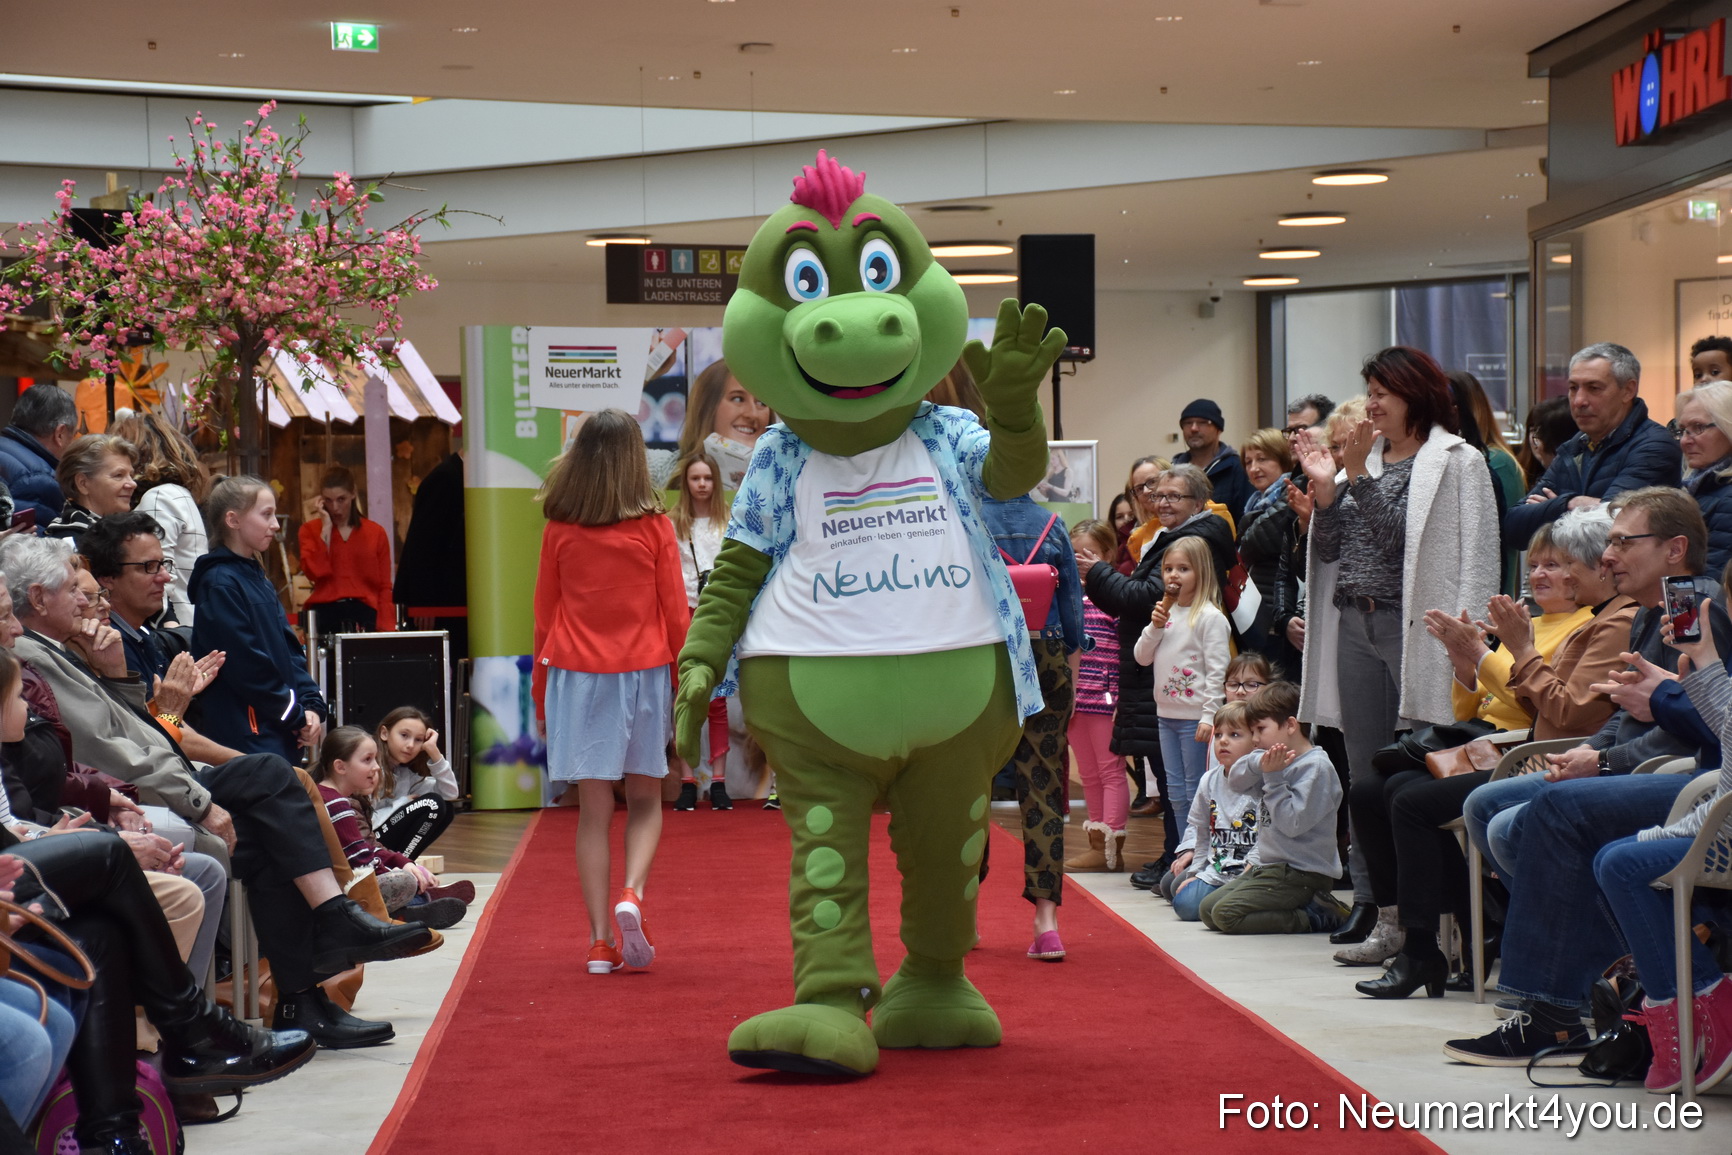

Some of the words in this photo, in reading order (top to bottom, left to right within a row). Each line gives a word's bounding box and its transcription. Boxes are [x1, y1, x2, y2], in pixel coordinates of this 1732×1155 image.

[1612, 17, 1732, 147] WÖHRL
[644, 279, 653, 287] IN
[656, 279, 673, 288] DER
[677, 279, 722, 289] UNTEREN
[644, 291, 722, 302] LADENSTRASSE
[142, 331, 151, 339] 12
[545, 366, 622, 379] NeuerMarkt
[821, 505, 948, 539] NeuerMarkt
[830, 534, 873, 550] einkaufen
[877, 531, 902, 541] leben
[906, 528, 946, 540] genießen
[405, 798, 439, 815] FRANCISCO
[403, 835, 422, 858] FRANCIS
